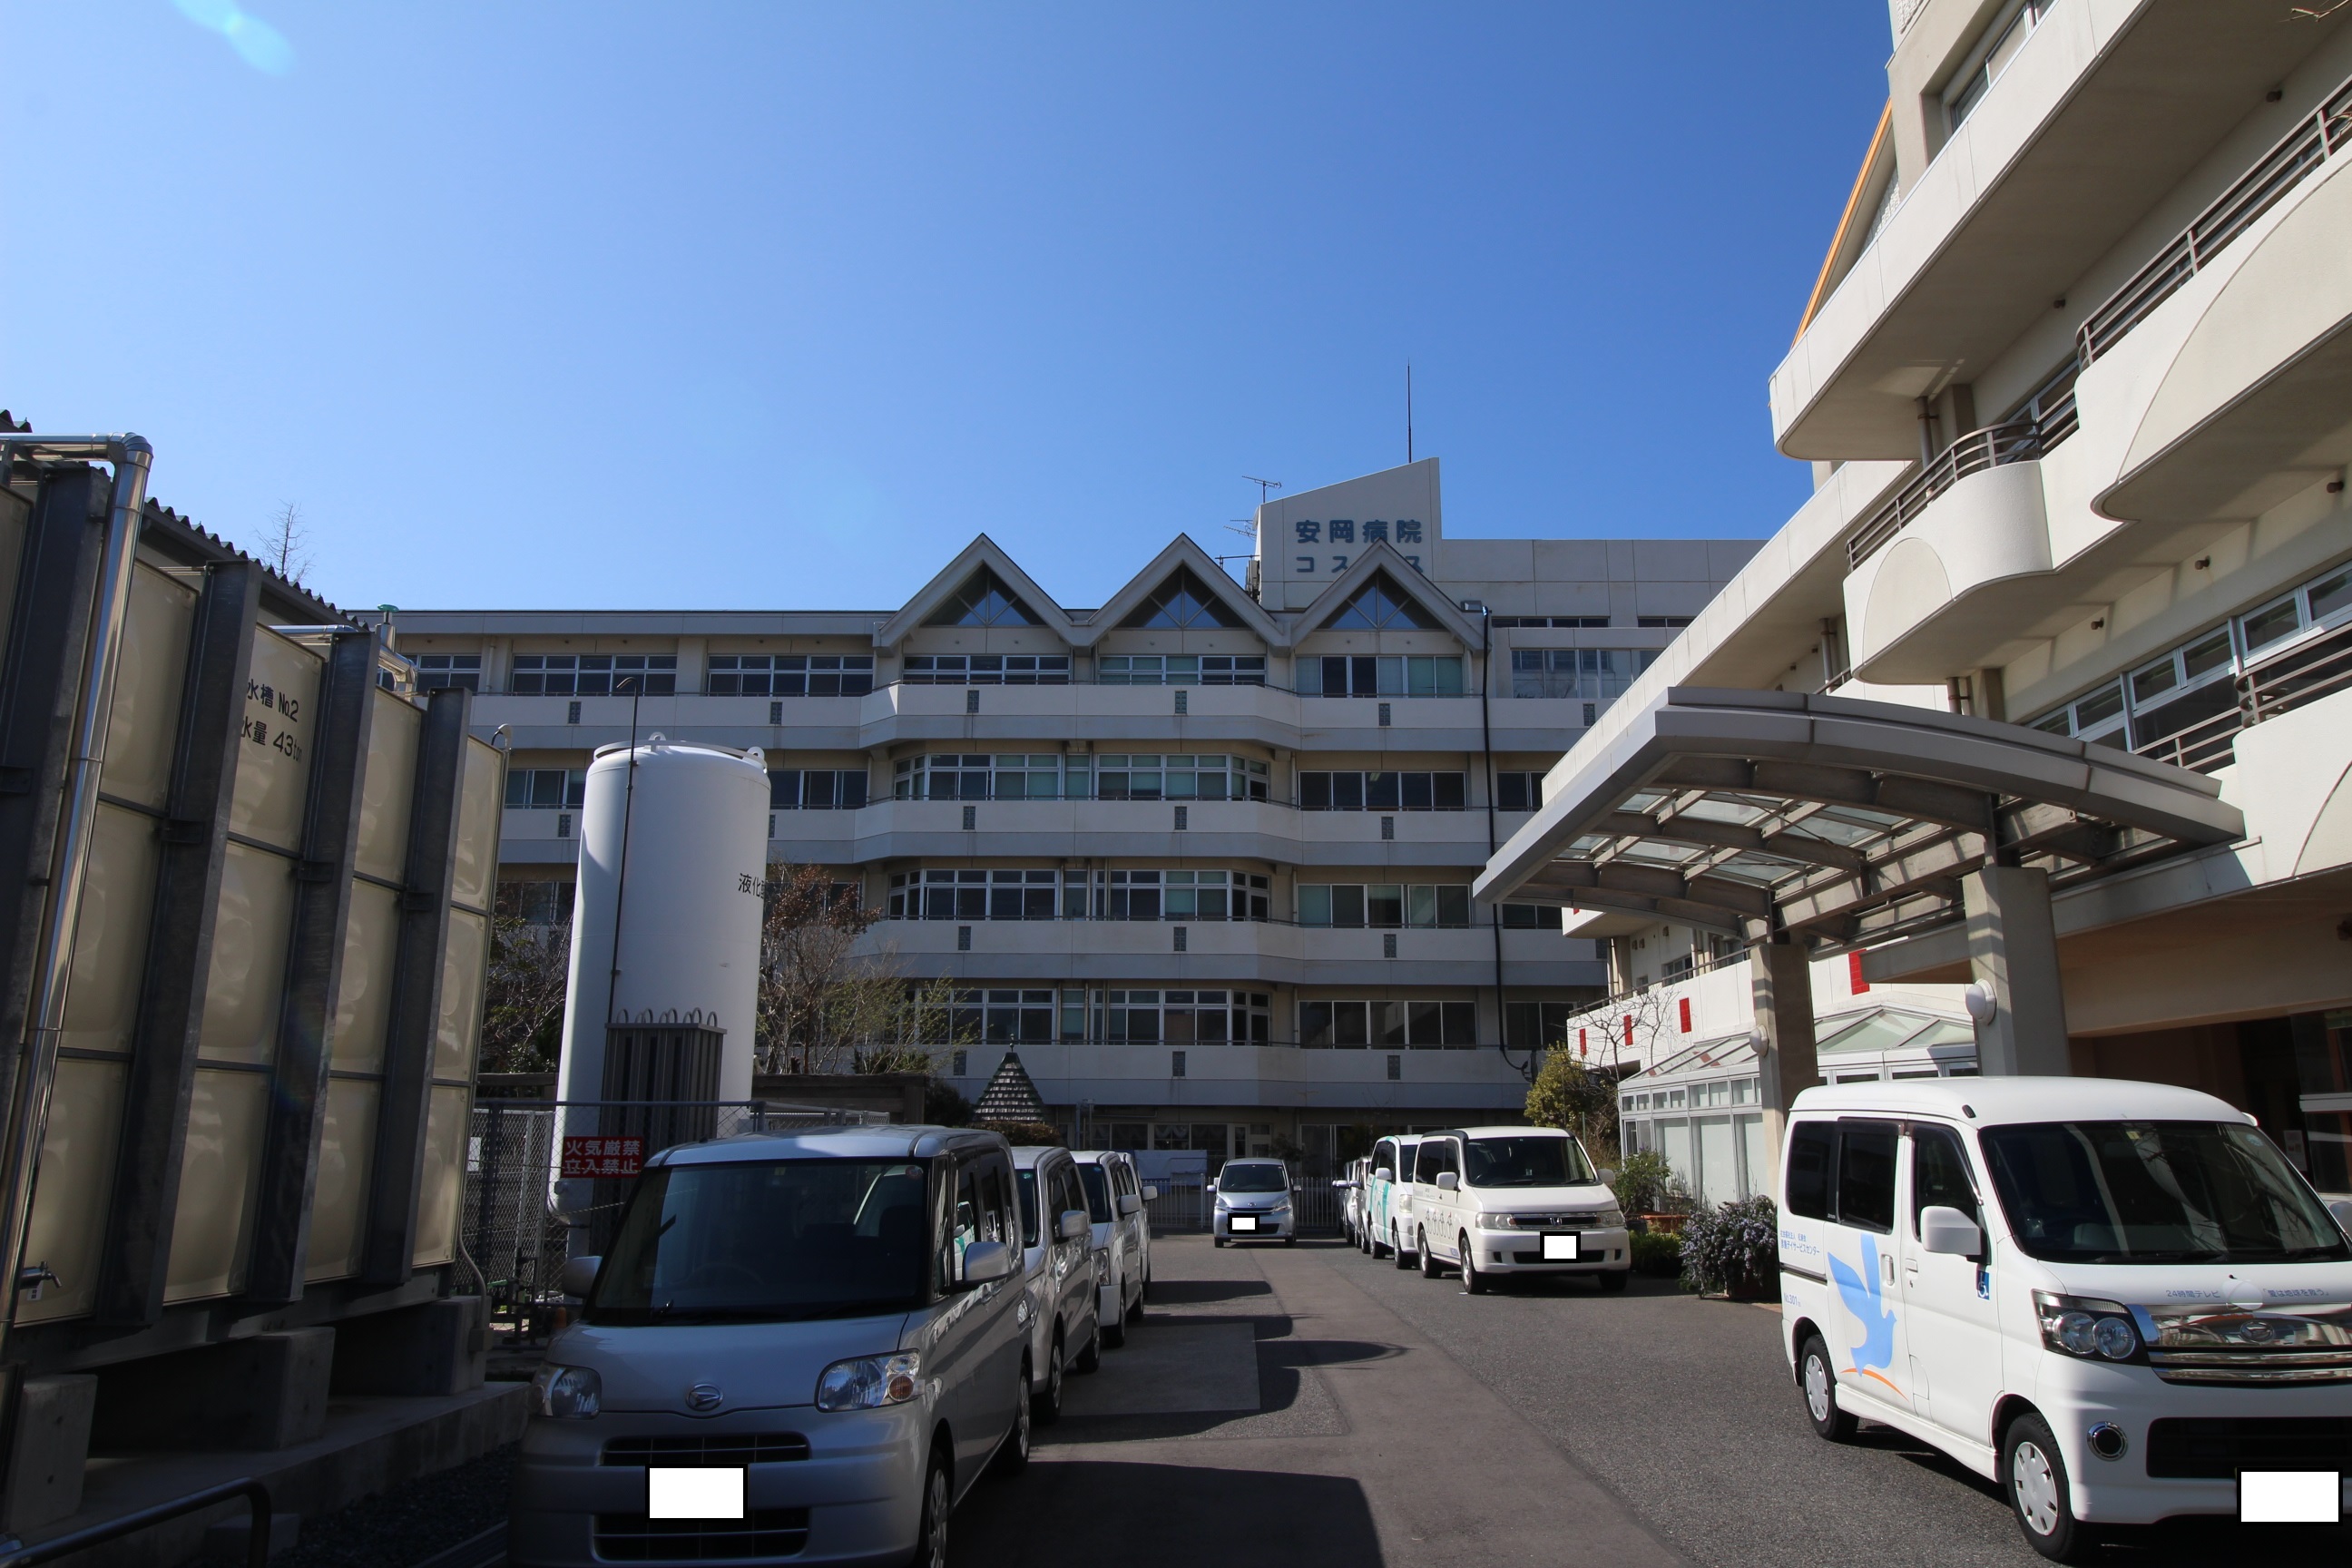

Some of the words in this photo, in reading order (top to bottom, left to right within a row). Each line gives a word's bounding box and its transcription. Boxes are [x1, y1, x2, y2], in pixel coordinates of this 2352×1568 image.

[1295, 519, 1422, 544] 安岡病院
[1296, 555, 1424, 573] コスス
[564, 1140, 641, 1156] 火気厳禁
[564, 1158, 639, 1175] 立入禁止
[2165, 1289, 2221, 1298] 24時間テレビ
